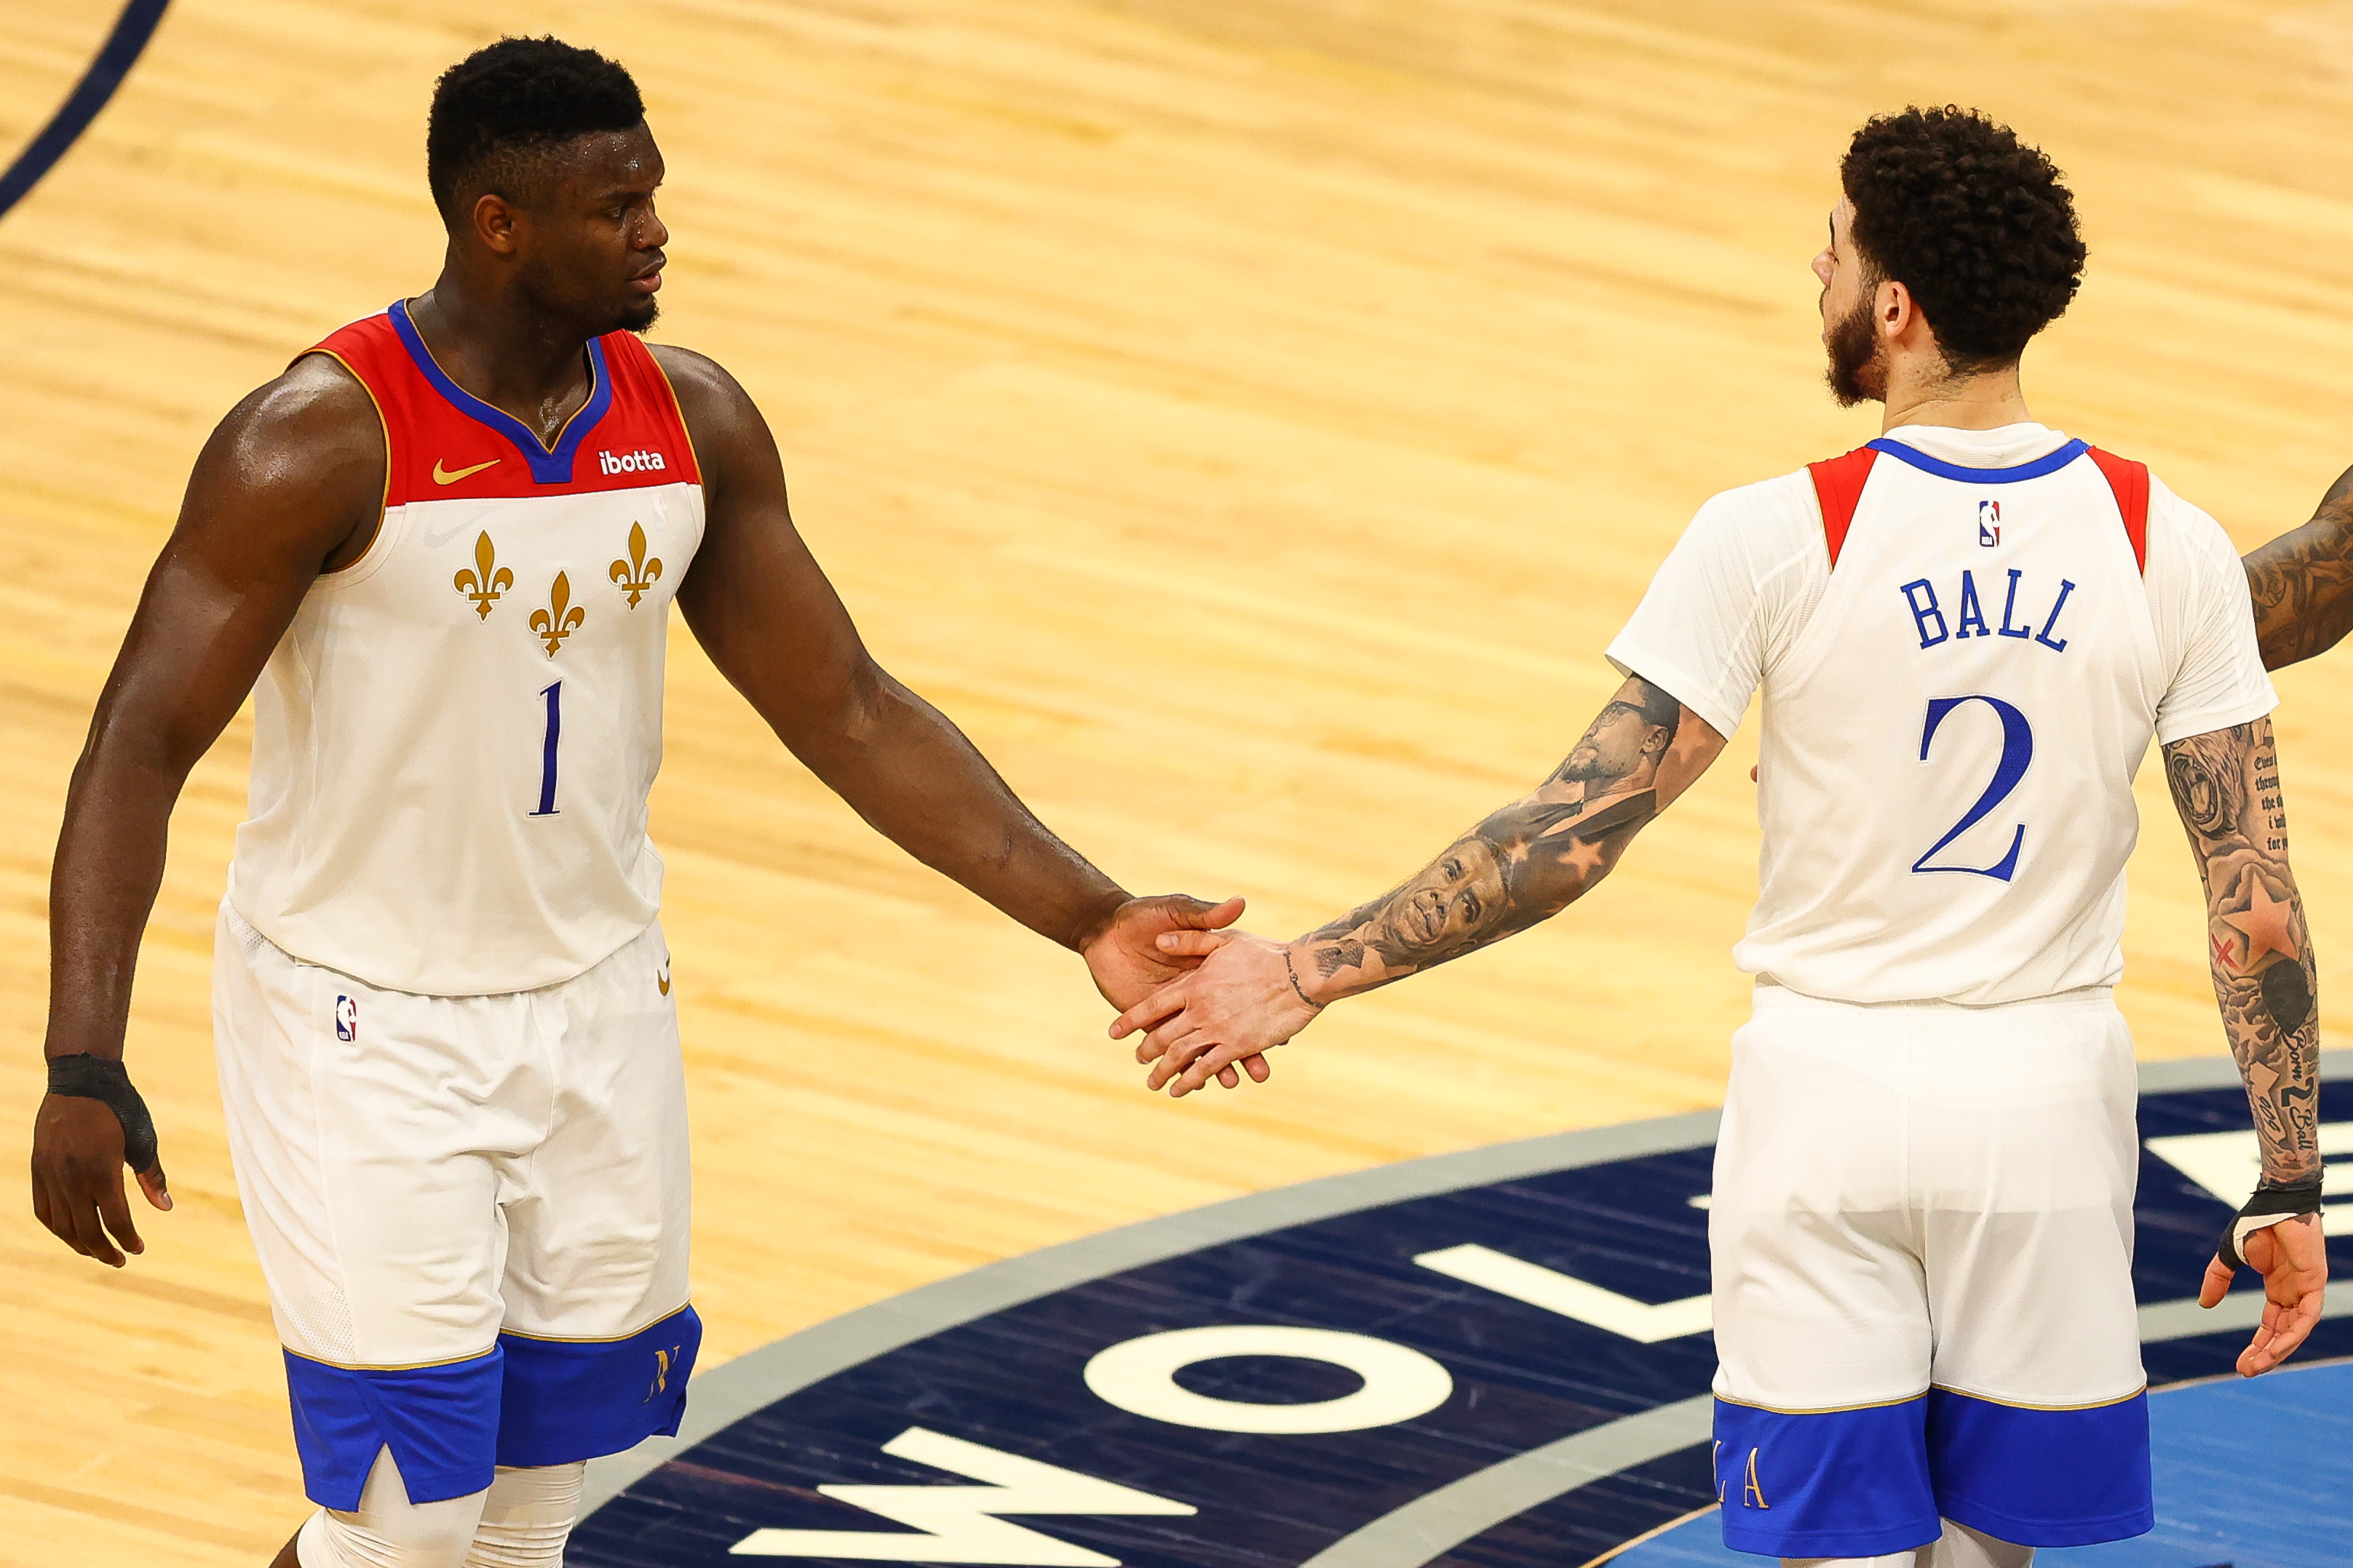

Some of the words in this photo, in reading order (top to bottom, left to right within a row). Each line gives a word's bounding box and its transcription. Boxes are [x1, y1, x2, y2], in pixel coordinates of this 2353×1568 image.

[598, 450, 666, 475] ibotta
[1900, 568, 2076, 652] BALL
[527, 679, 563, 816] 1
[1911, 695, 2034, 883] 2
[2281, 1028, 2307, 1082] Born
[2281, 1076, 2314, 1107] 2
[2289, 1106, 2314, 1150] Ball
